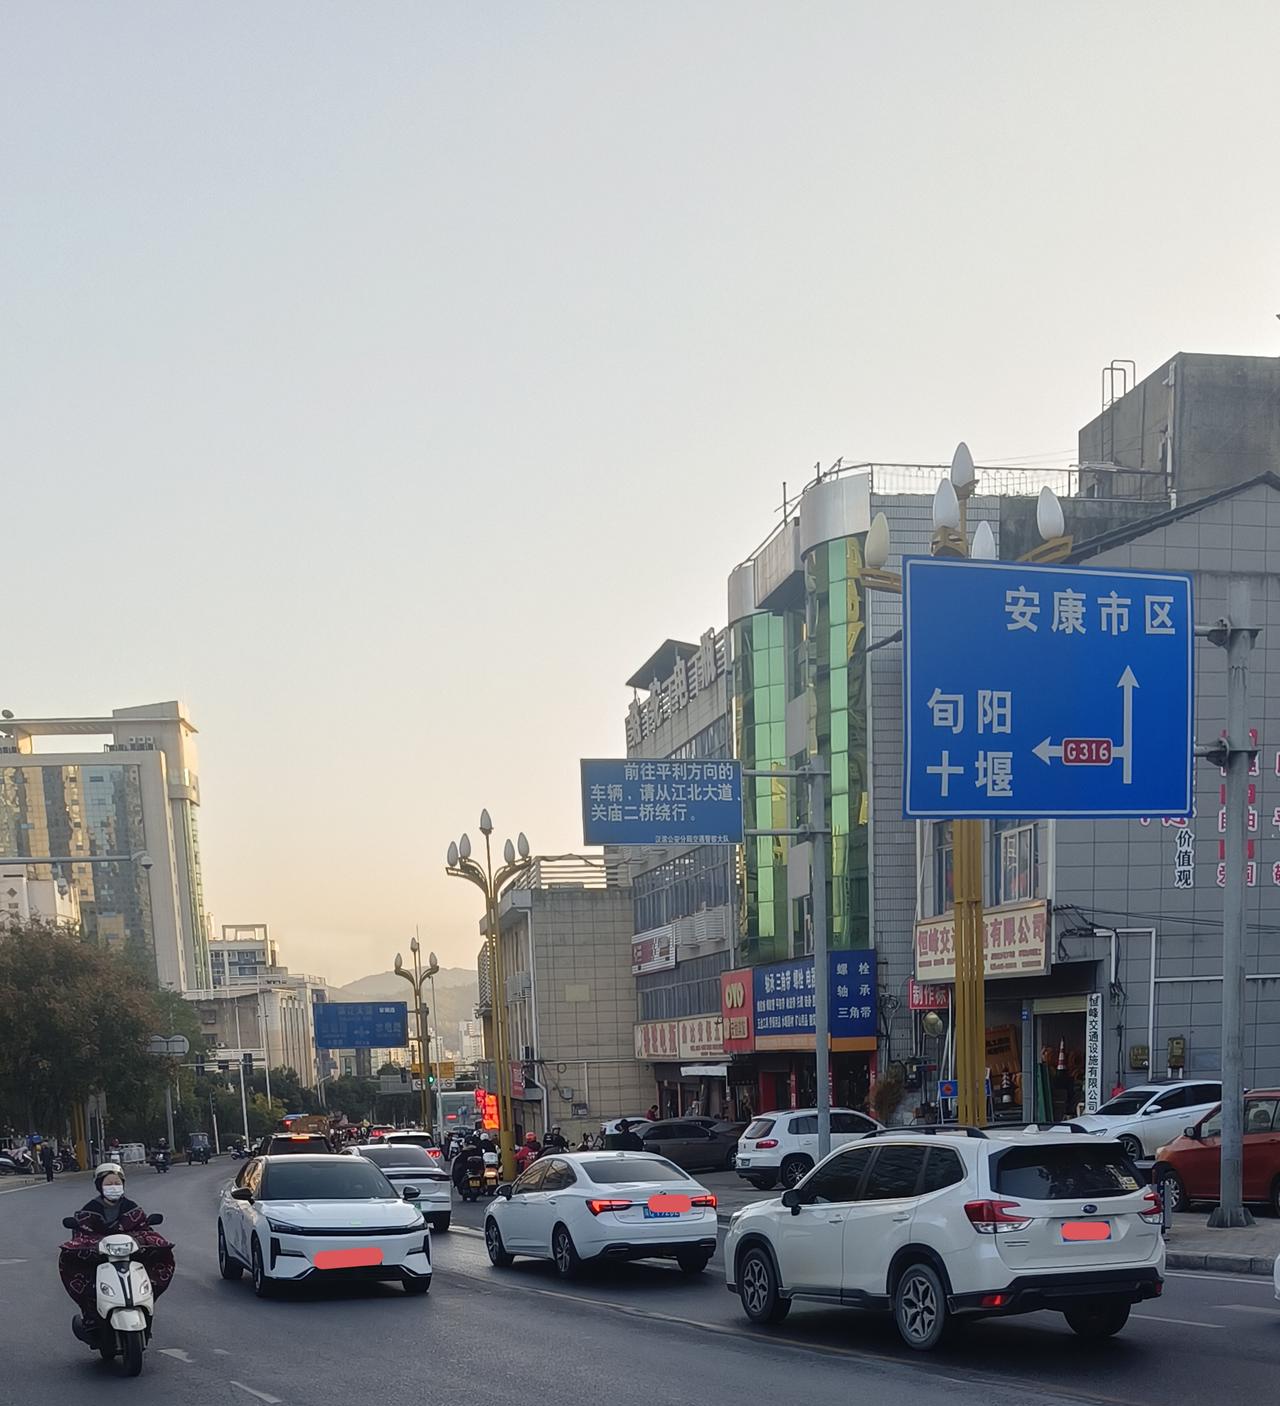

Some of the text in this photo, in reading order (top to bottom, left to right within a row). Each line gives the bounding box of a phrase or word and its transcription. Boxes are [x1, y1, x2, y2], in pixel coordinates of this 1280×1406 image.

[1005, 585, 1176, 636] 安康市区
[927, 687, 1012, 734] 旬阳
[1066, 742, 1110, 761] G316
[624, 763, 734, 781] 前往平利方向的
[926, 750, 1013, 797] 十堰
[1175, 829, 1194, 888] 价值观
[836, 961, 871, 976] 螺栓
[725, 982, 744, 1009] OYO
[836, 984, 871, 998] 轴承
[837, 1006, 872, 1019] 三角带
[1088, 994, 1099, 1112] 恒峰交通设施有限公司
